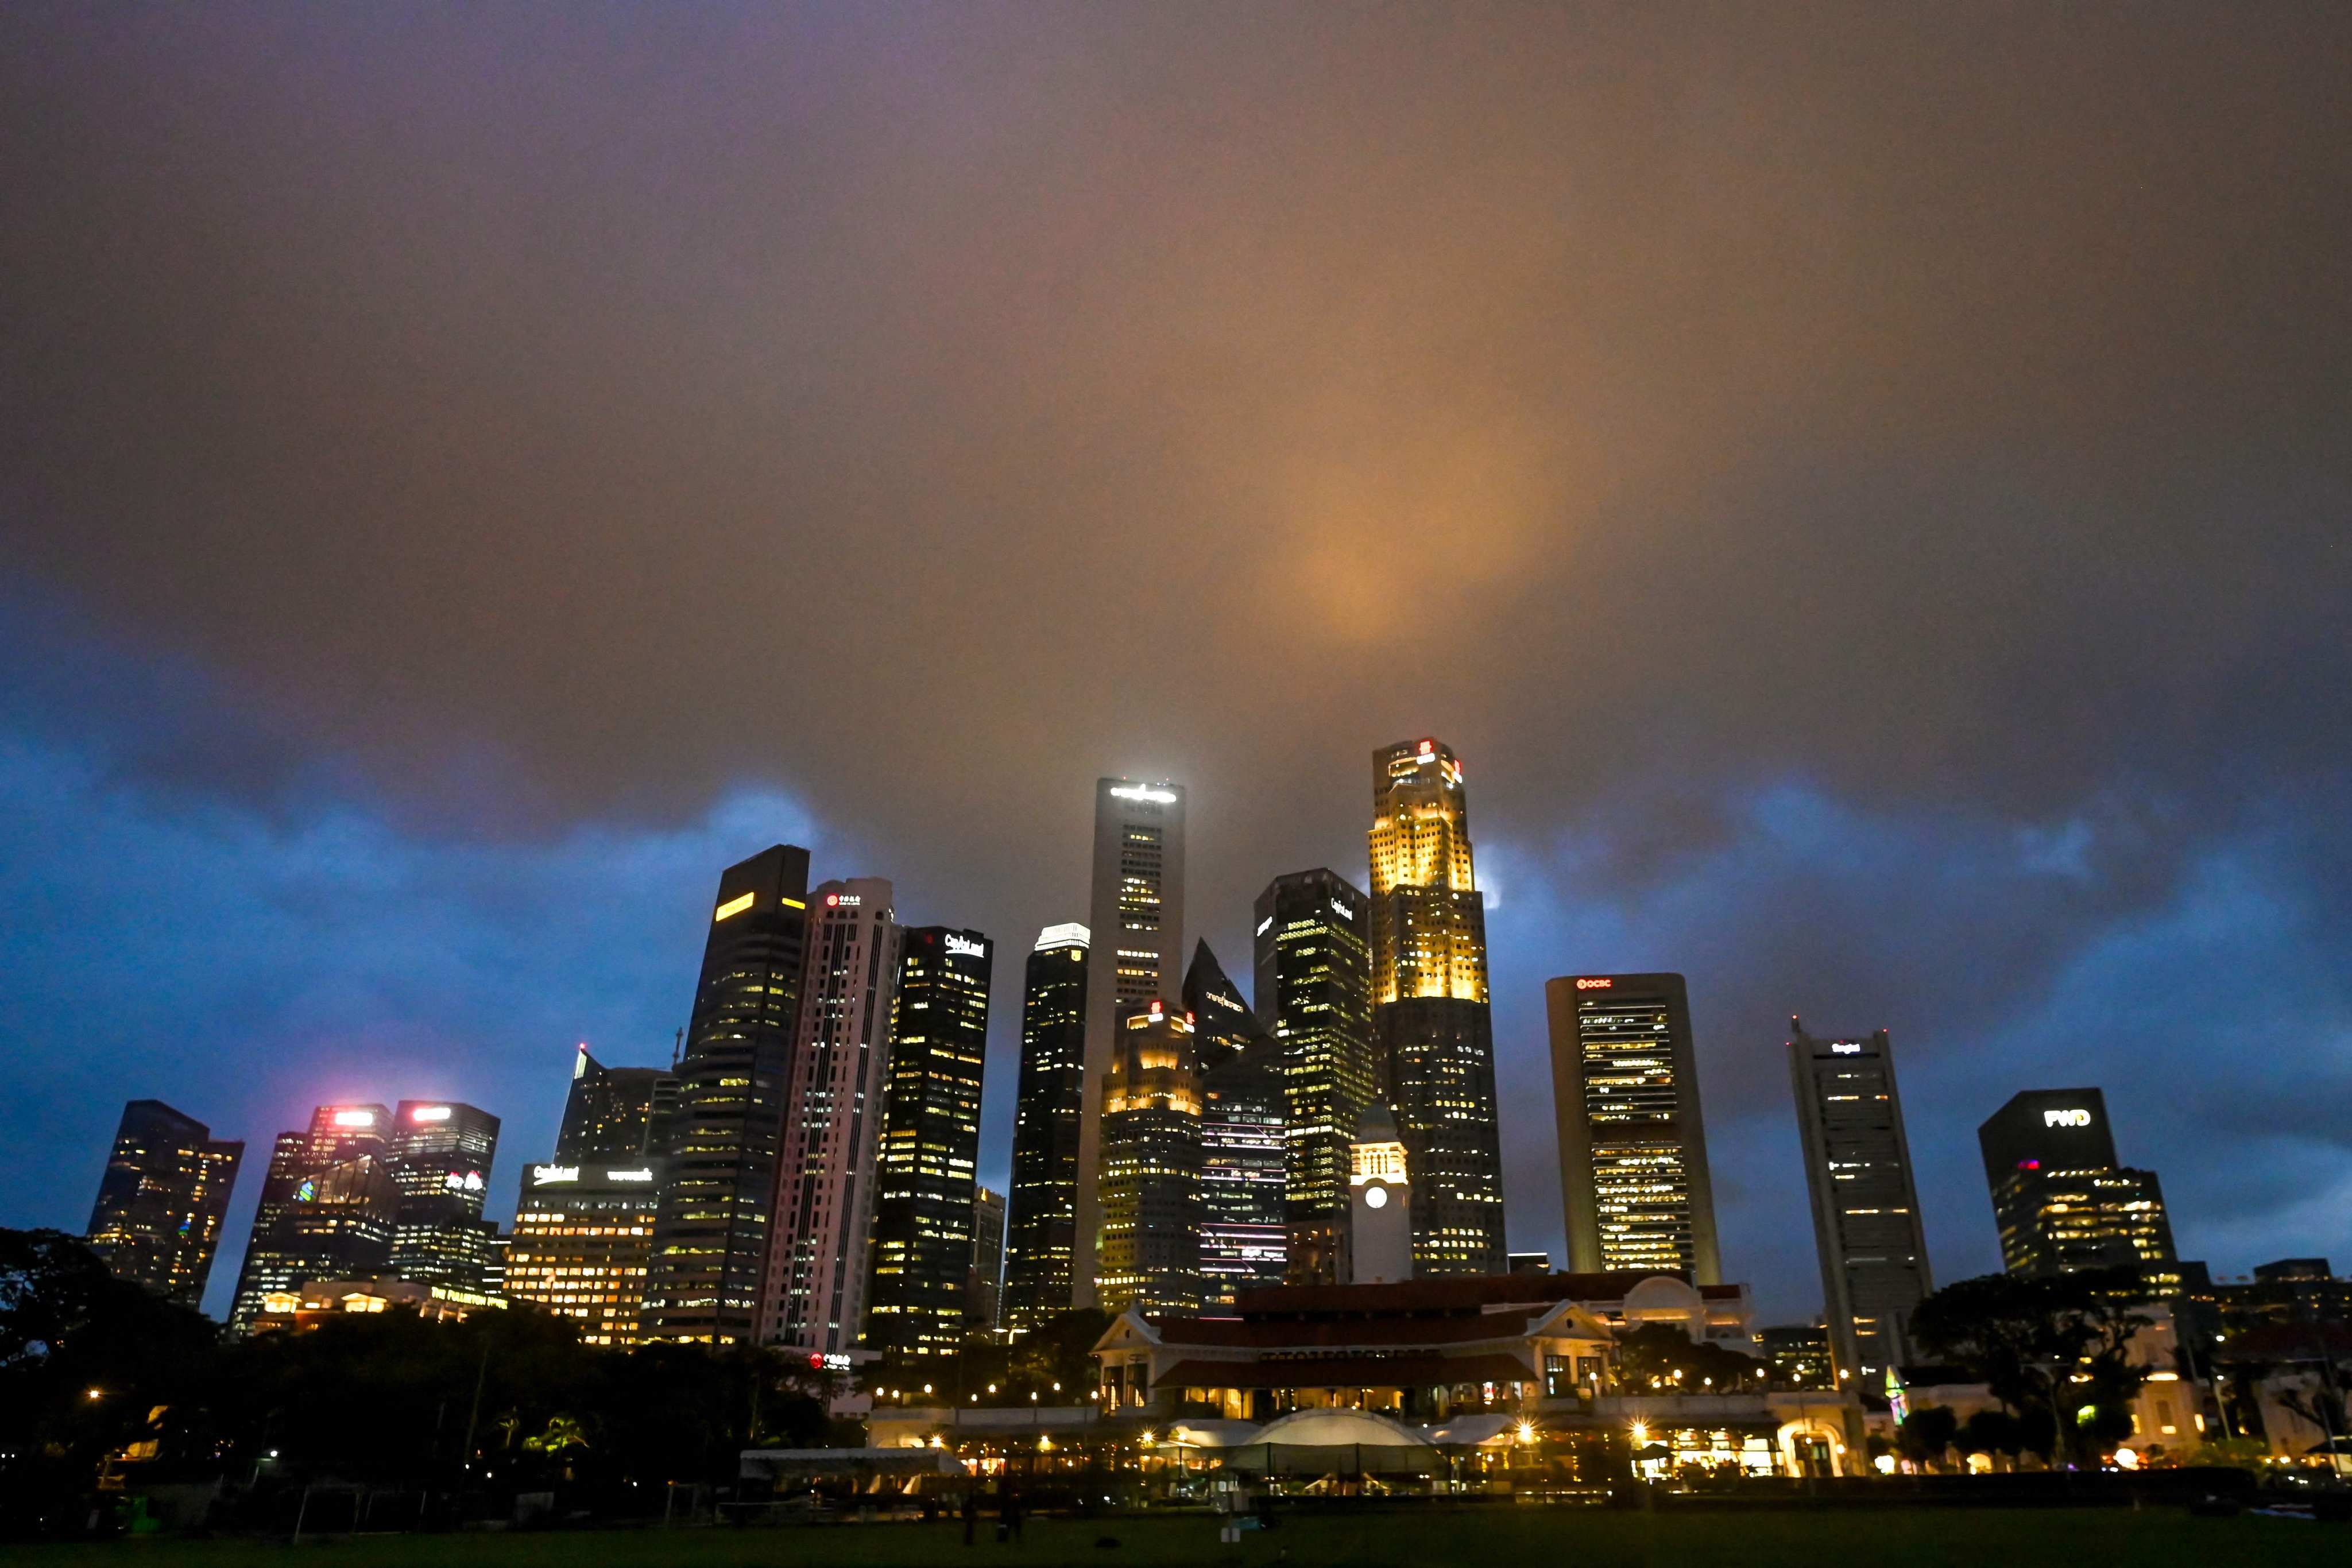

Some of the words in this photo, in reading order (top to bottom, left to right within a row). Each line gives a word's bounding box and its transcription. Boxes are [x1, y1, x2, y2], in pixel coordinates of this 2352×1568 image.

[1587, 979, 1611, 988] OCBC
[2044, 1109, 2091, 1127] FWD
[431, 1286, 446, 1300] THE
[447, 1290, 486, 1306] FULLERTON
